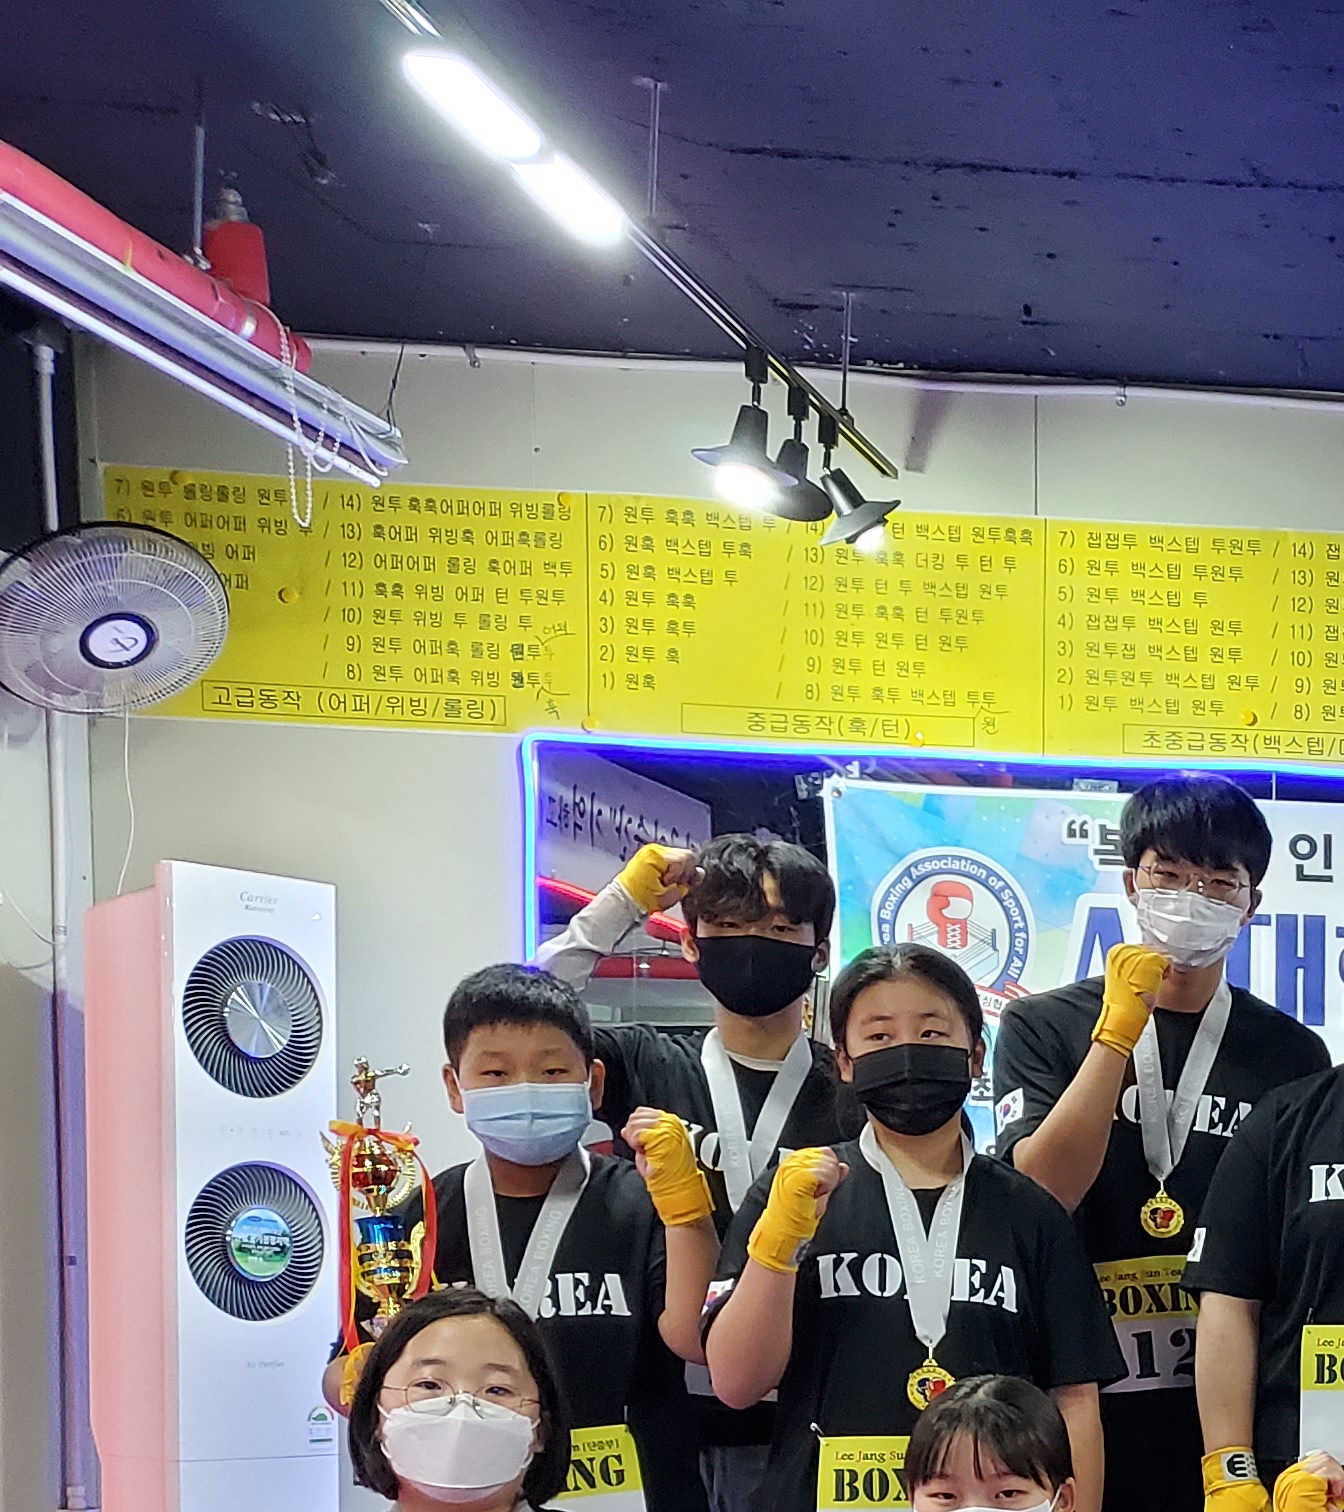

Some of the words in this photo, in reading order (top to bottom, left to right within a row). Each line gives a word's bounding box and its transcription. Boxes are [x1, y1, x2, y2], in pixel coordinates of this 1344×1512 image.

[1059, 531, 1075, 548] 7)
[1087, 532, 1137, 550] 잽잽투
[1149, 536, 1199, 553] 백스텝
[1212, 538, 1262, 555] 투원투
[1292, 542, 1314, 560] 14)
[1059, 558, 1074, 575] 6)
[1086, 560, 1119, 577] 원투
[1131, 561, 1181, 579] 백스텝
[1193, 565, 1244, 582] 투원투
[211, 686, 303, 713] 고급동작
[880, 877, 913, 919] Boxing
[909, 857, 987, 880] Association
[988, 872, 1002, 890] of
[1001, 889, 1024, 929] Sport
[816, 1253, 1017, 1313] KOEA
